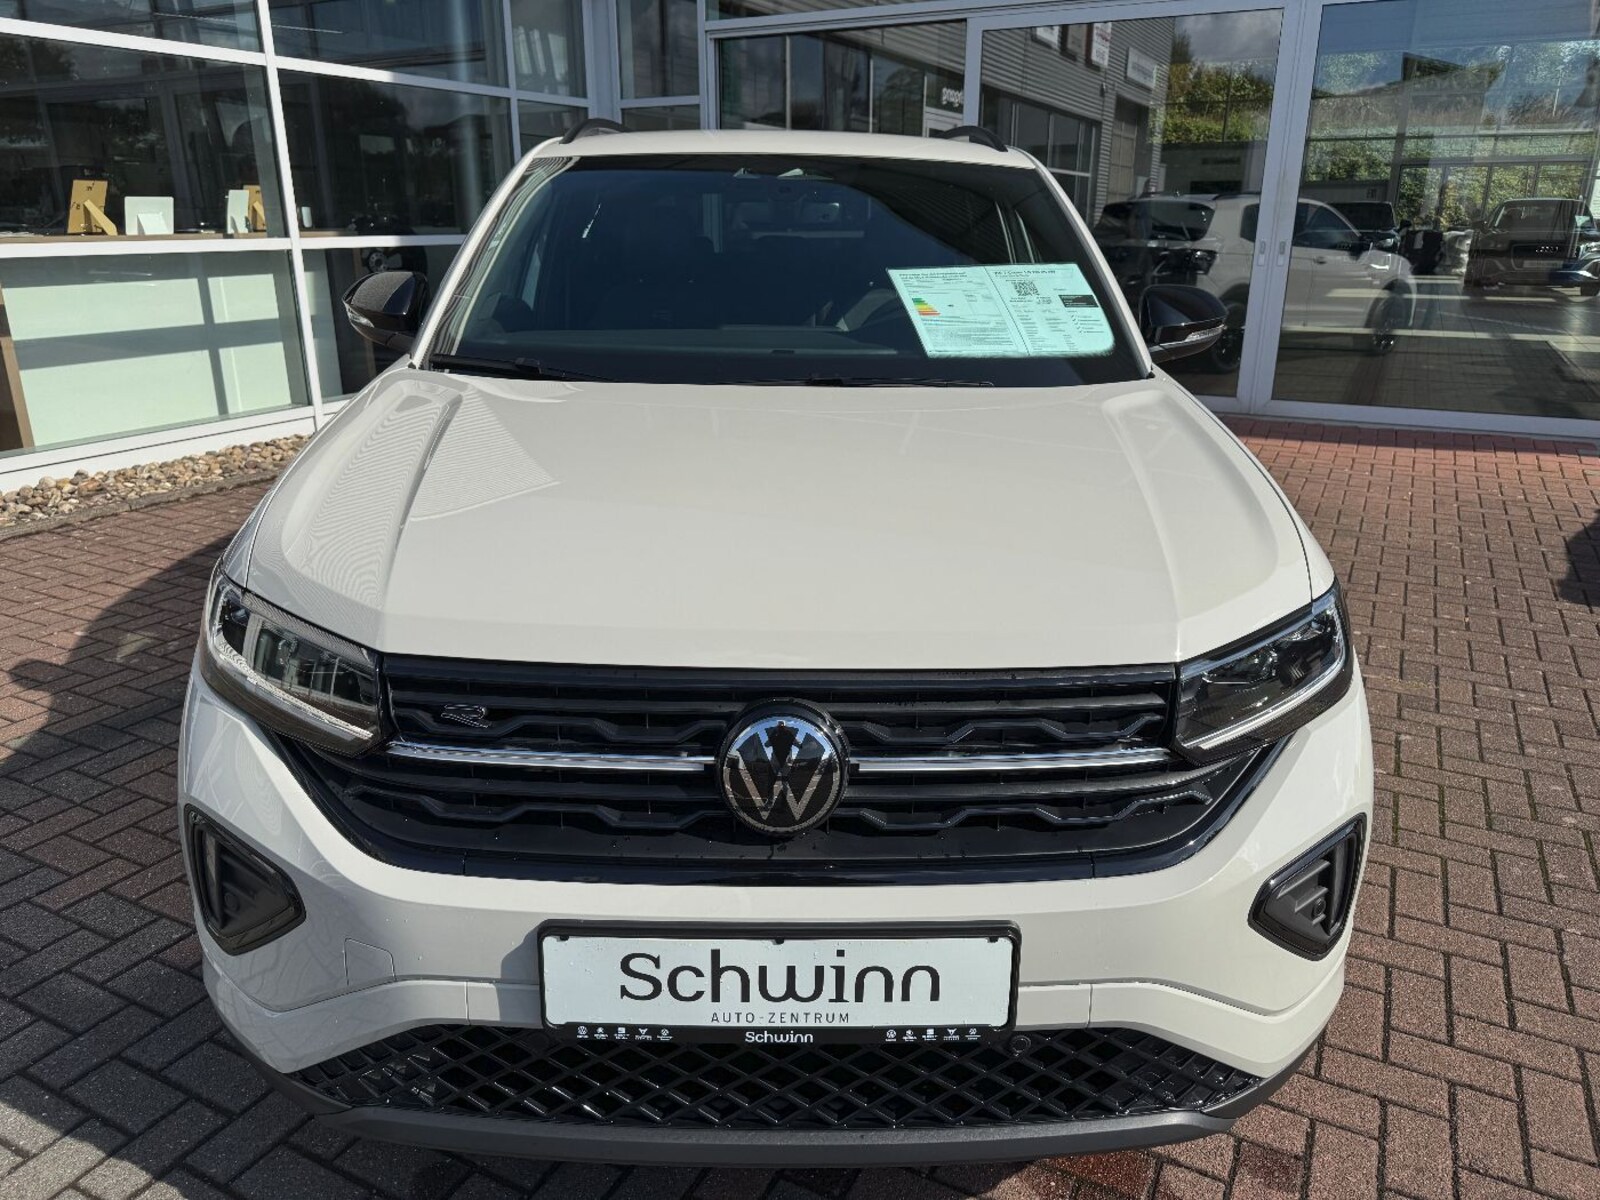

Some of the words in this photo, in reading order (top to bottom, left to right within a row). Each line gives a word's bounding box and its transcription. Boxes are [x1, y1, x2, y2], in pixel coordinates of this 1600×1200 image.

[620, 948, 940, 1003] Schwinn
[710, 1012, 850, 1024] AUTO-ZENTRUM
[744, 1030, 815, 1043] Schwinn
